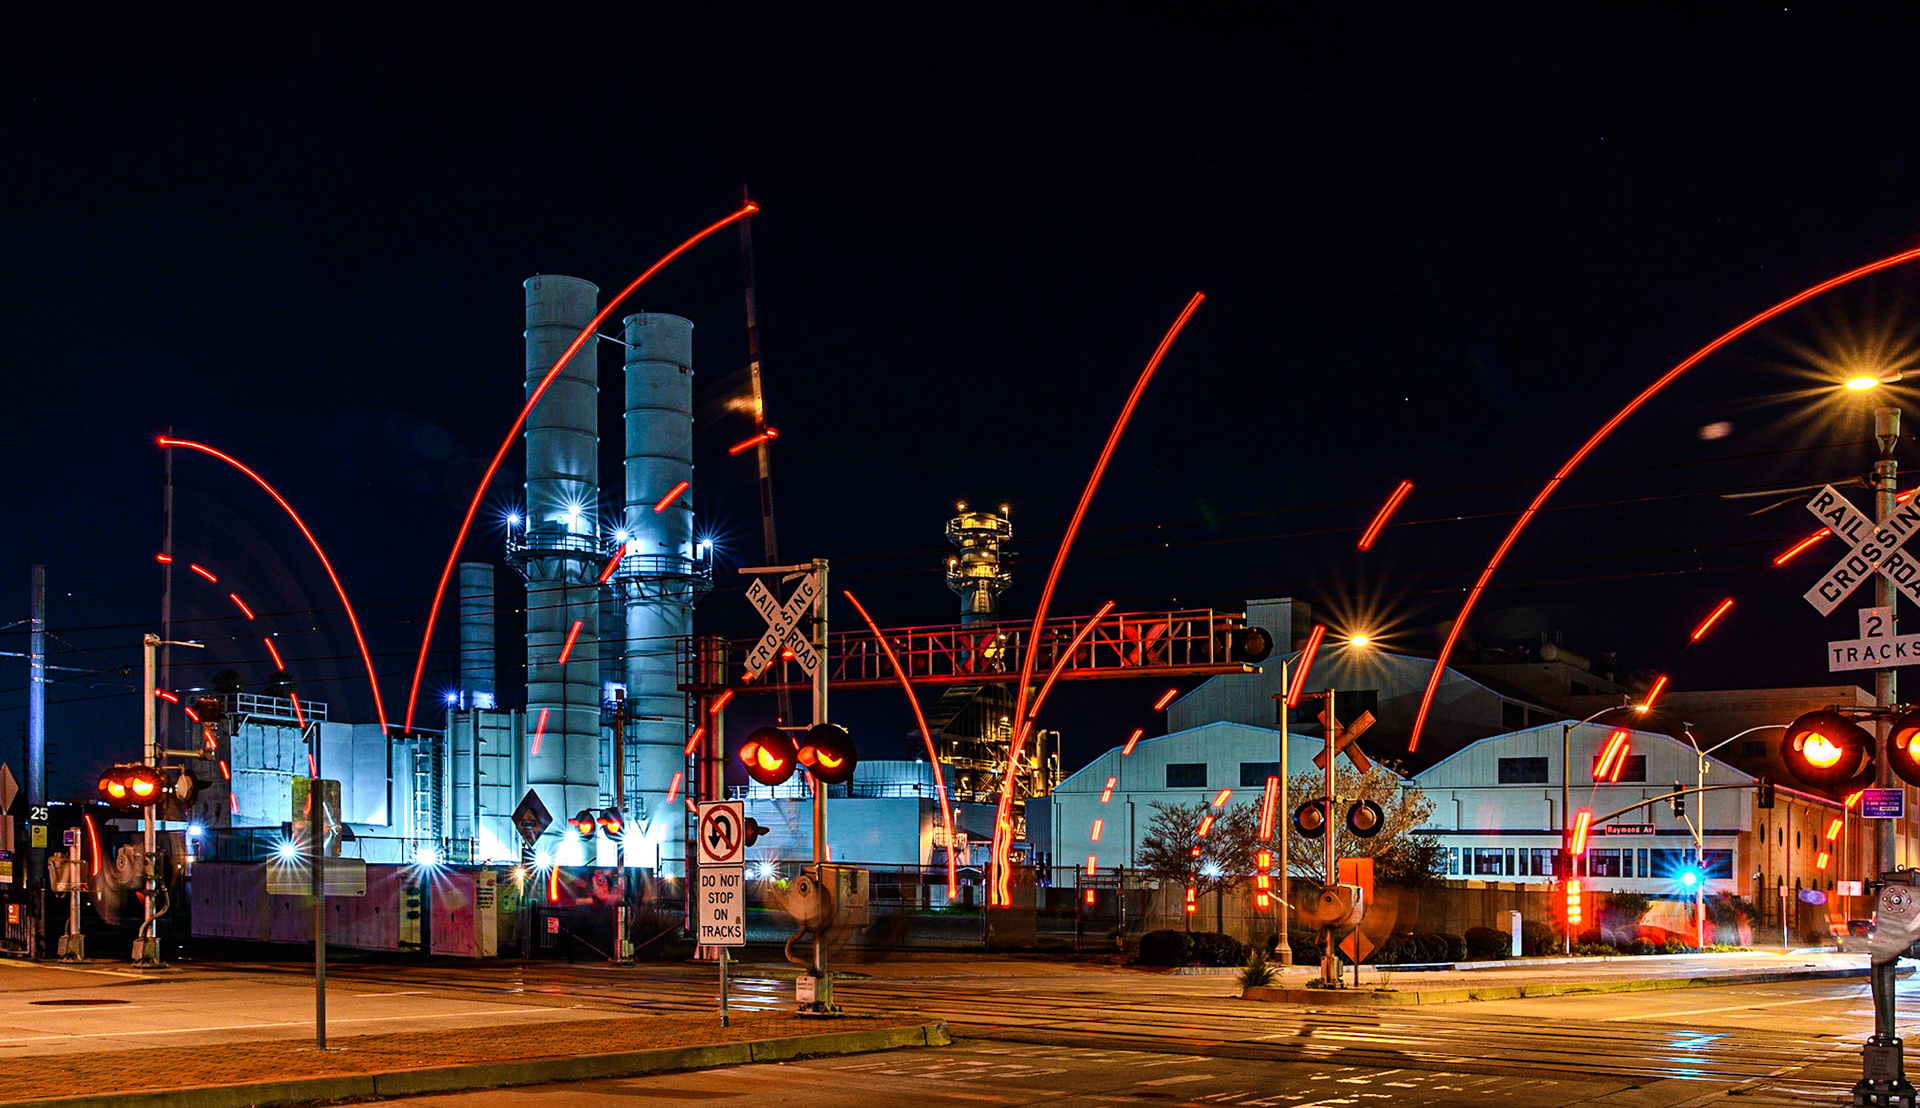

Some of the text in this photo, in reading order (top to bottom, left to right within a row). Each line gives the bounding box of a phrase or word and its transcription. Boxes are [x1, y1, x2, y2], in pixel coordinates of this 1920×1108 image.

[1812, 491, 1920, 599] RAIL ROA
[749, 583, 817, 670] RAIL ROAD
[750, 583, 814, 670] CROSSING
[1866, 616, 1883, 638] 2
[1833, 641, 1920, 663] TRACKS
[30, 806, 48, 821] 25
[1607, 826, 1640, 834] Raymond
[702, 875, 740, 887] DO NOT
[708, 892, 734, 904] STOP
[714, 908, 728, 921] ON
[701, 925, 742, 938] TRACKS
